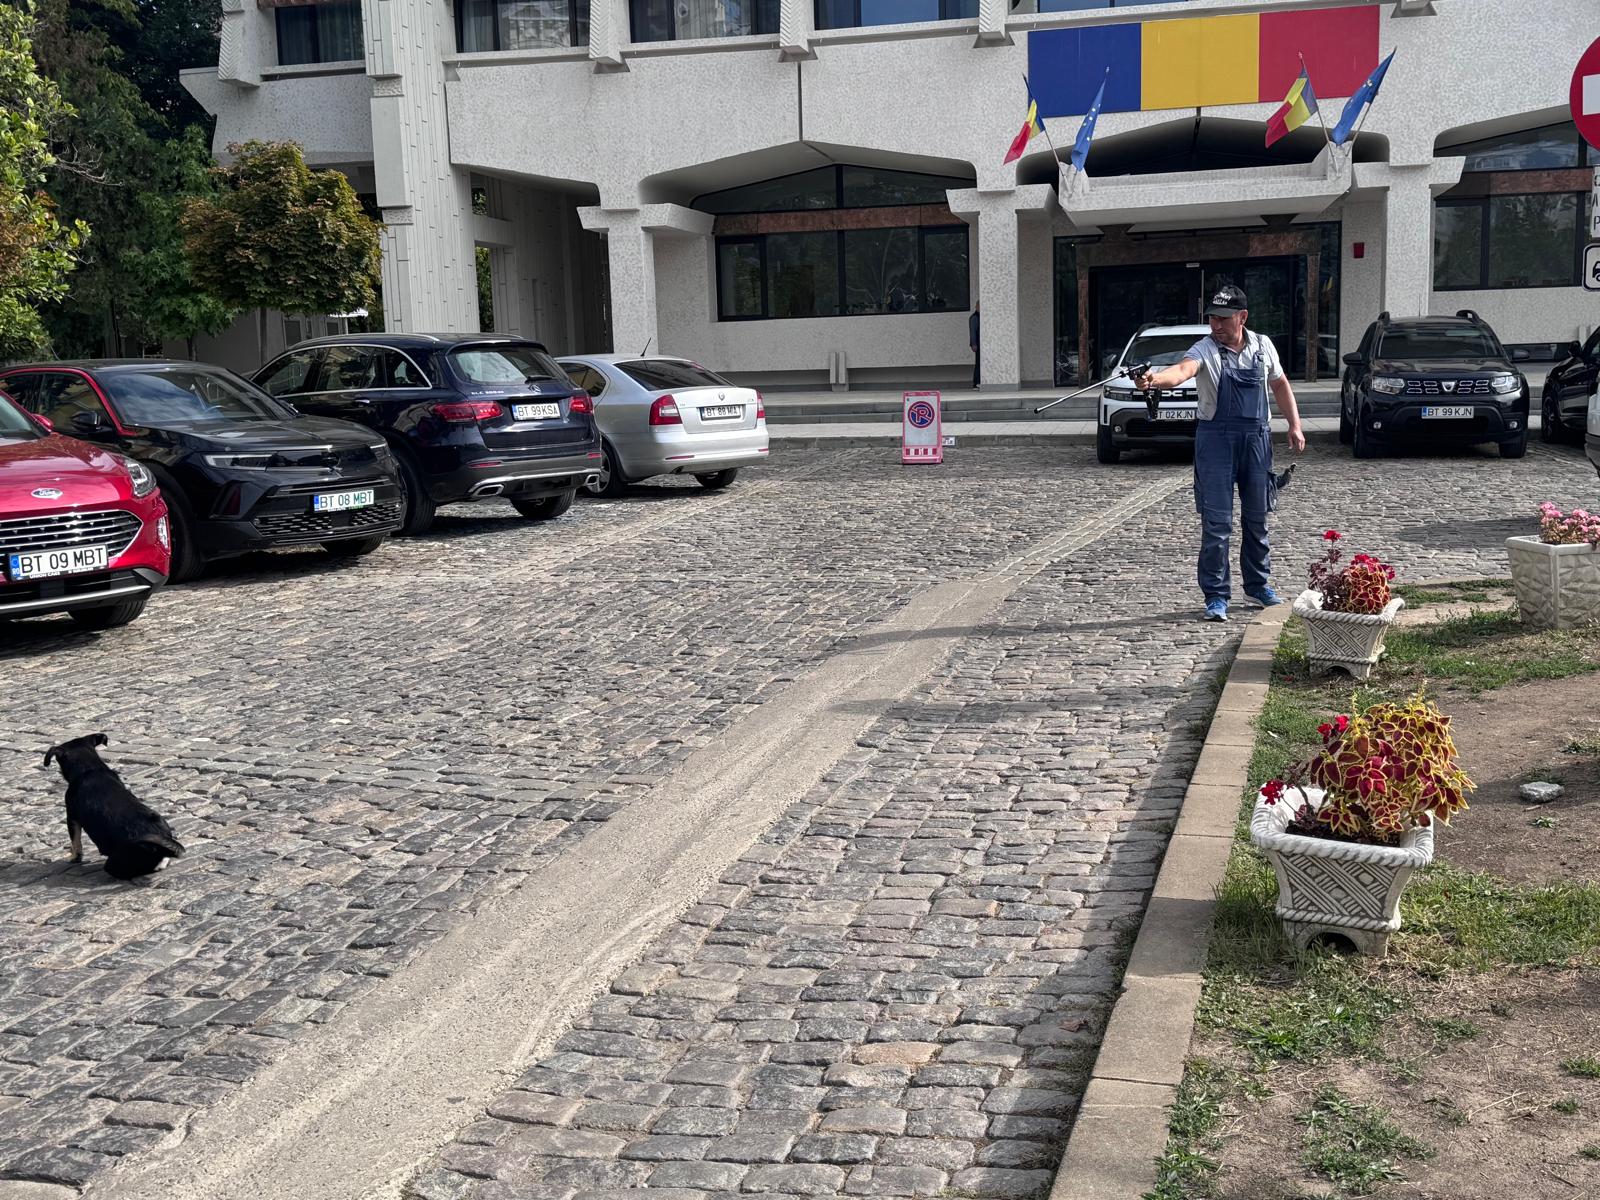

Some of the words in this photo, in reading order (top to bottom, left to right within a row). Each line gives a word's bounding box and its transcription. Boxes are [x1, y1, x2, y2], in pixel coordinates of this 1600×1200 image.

[518, 406, 528, 416] BT
[531, 405, 541, 415] 99
[541, 405, 558, 415] KSA
[707, 407, 715, 416] BT
[718, 406, 726, 415] 88
[1165, 411, 1175, 419] 02
[1176, 410, 1193, 419] KJN
[1428, 407, 1439, 416] BT
[1442, 407, 1452, 416] 99
[1454, 407, 1472, 416] KJN
[320, 496, 334, 508] BT
[338, 494, 350, 506] 08
[354, 491, 372, 504] MBT
[21, 555, 42, 574] BT
[49, 552, 68, 570] 09
[73, 548, 103, 567] MBT
